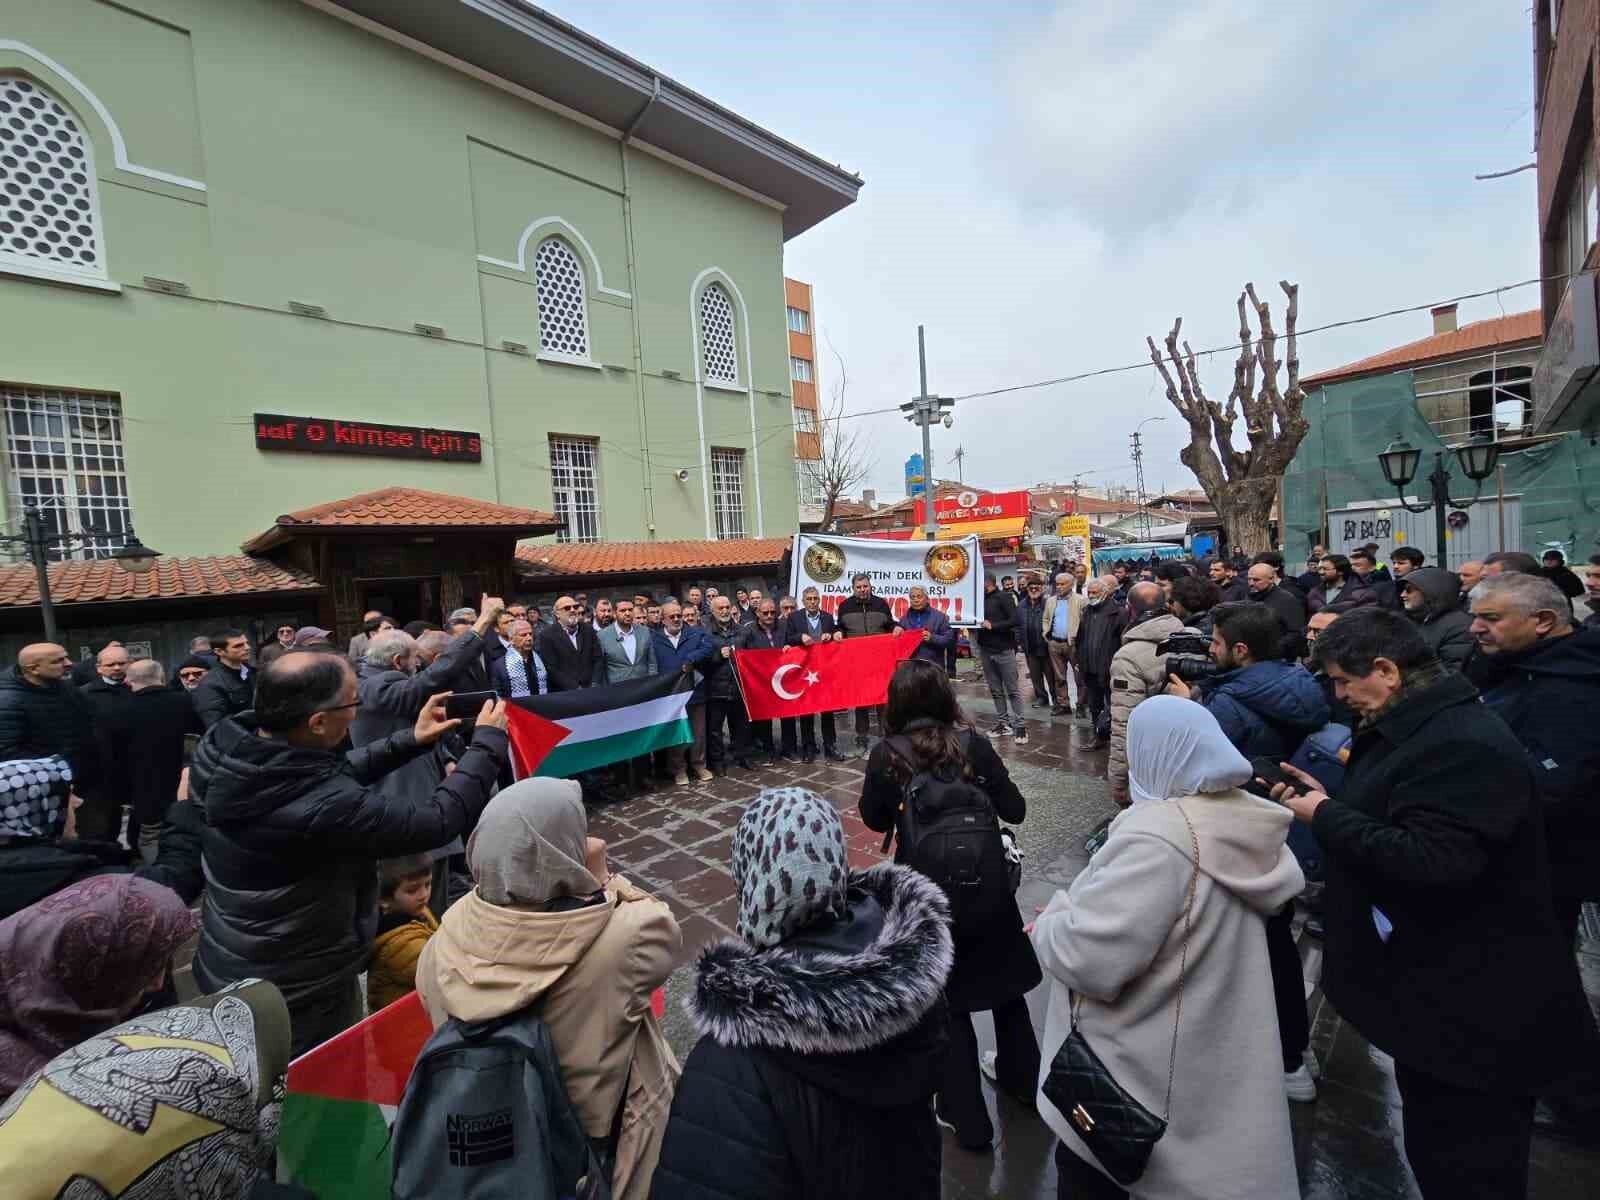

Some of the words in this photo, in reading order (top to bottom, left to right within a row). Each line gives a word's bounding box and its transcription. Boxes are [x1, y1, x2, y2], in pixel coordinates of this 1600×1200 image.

[306, 424, 327, 441] o
[335, 420, 415, 448] kimse
[421, 429, 464, 455] için
